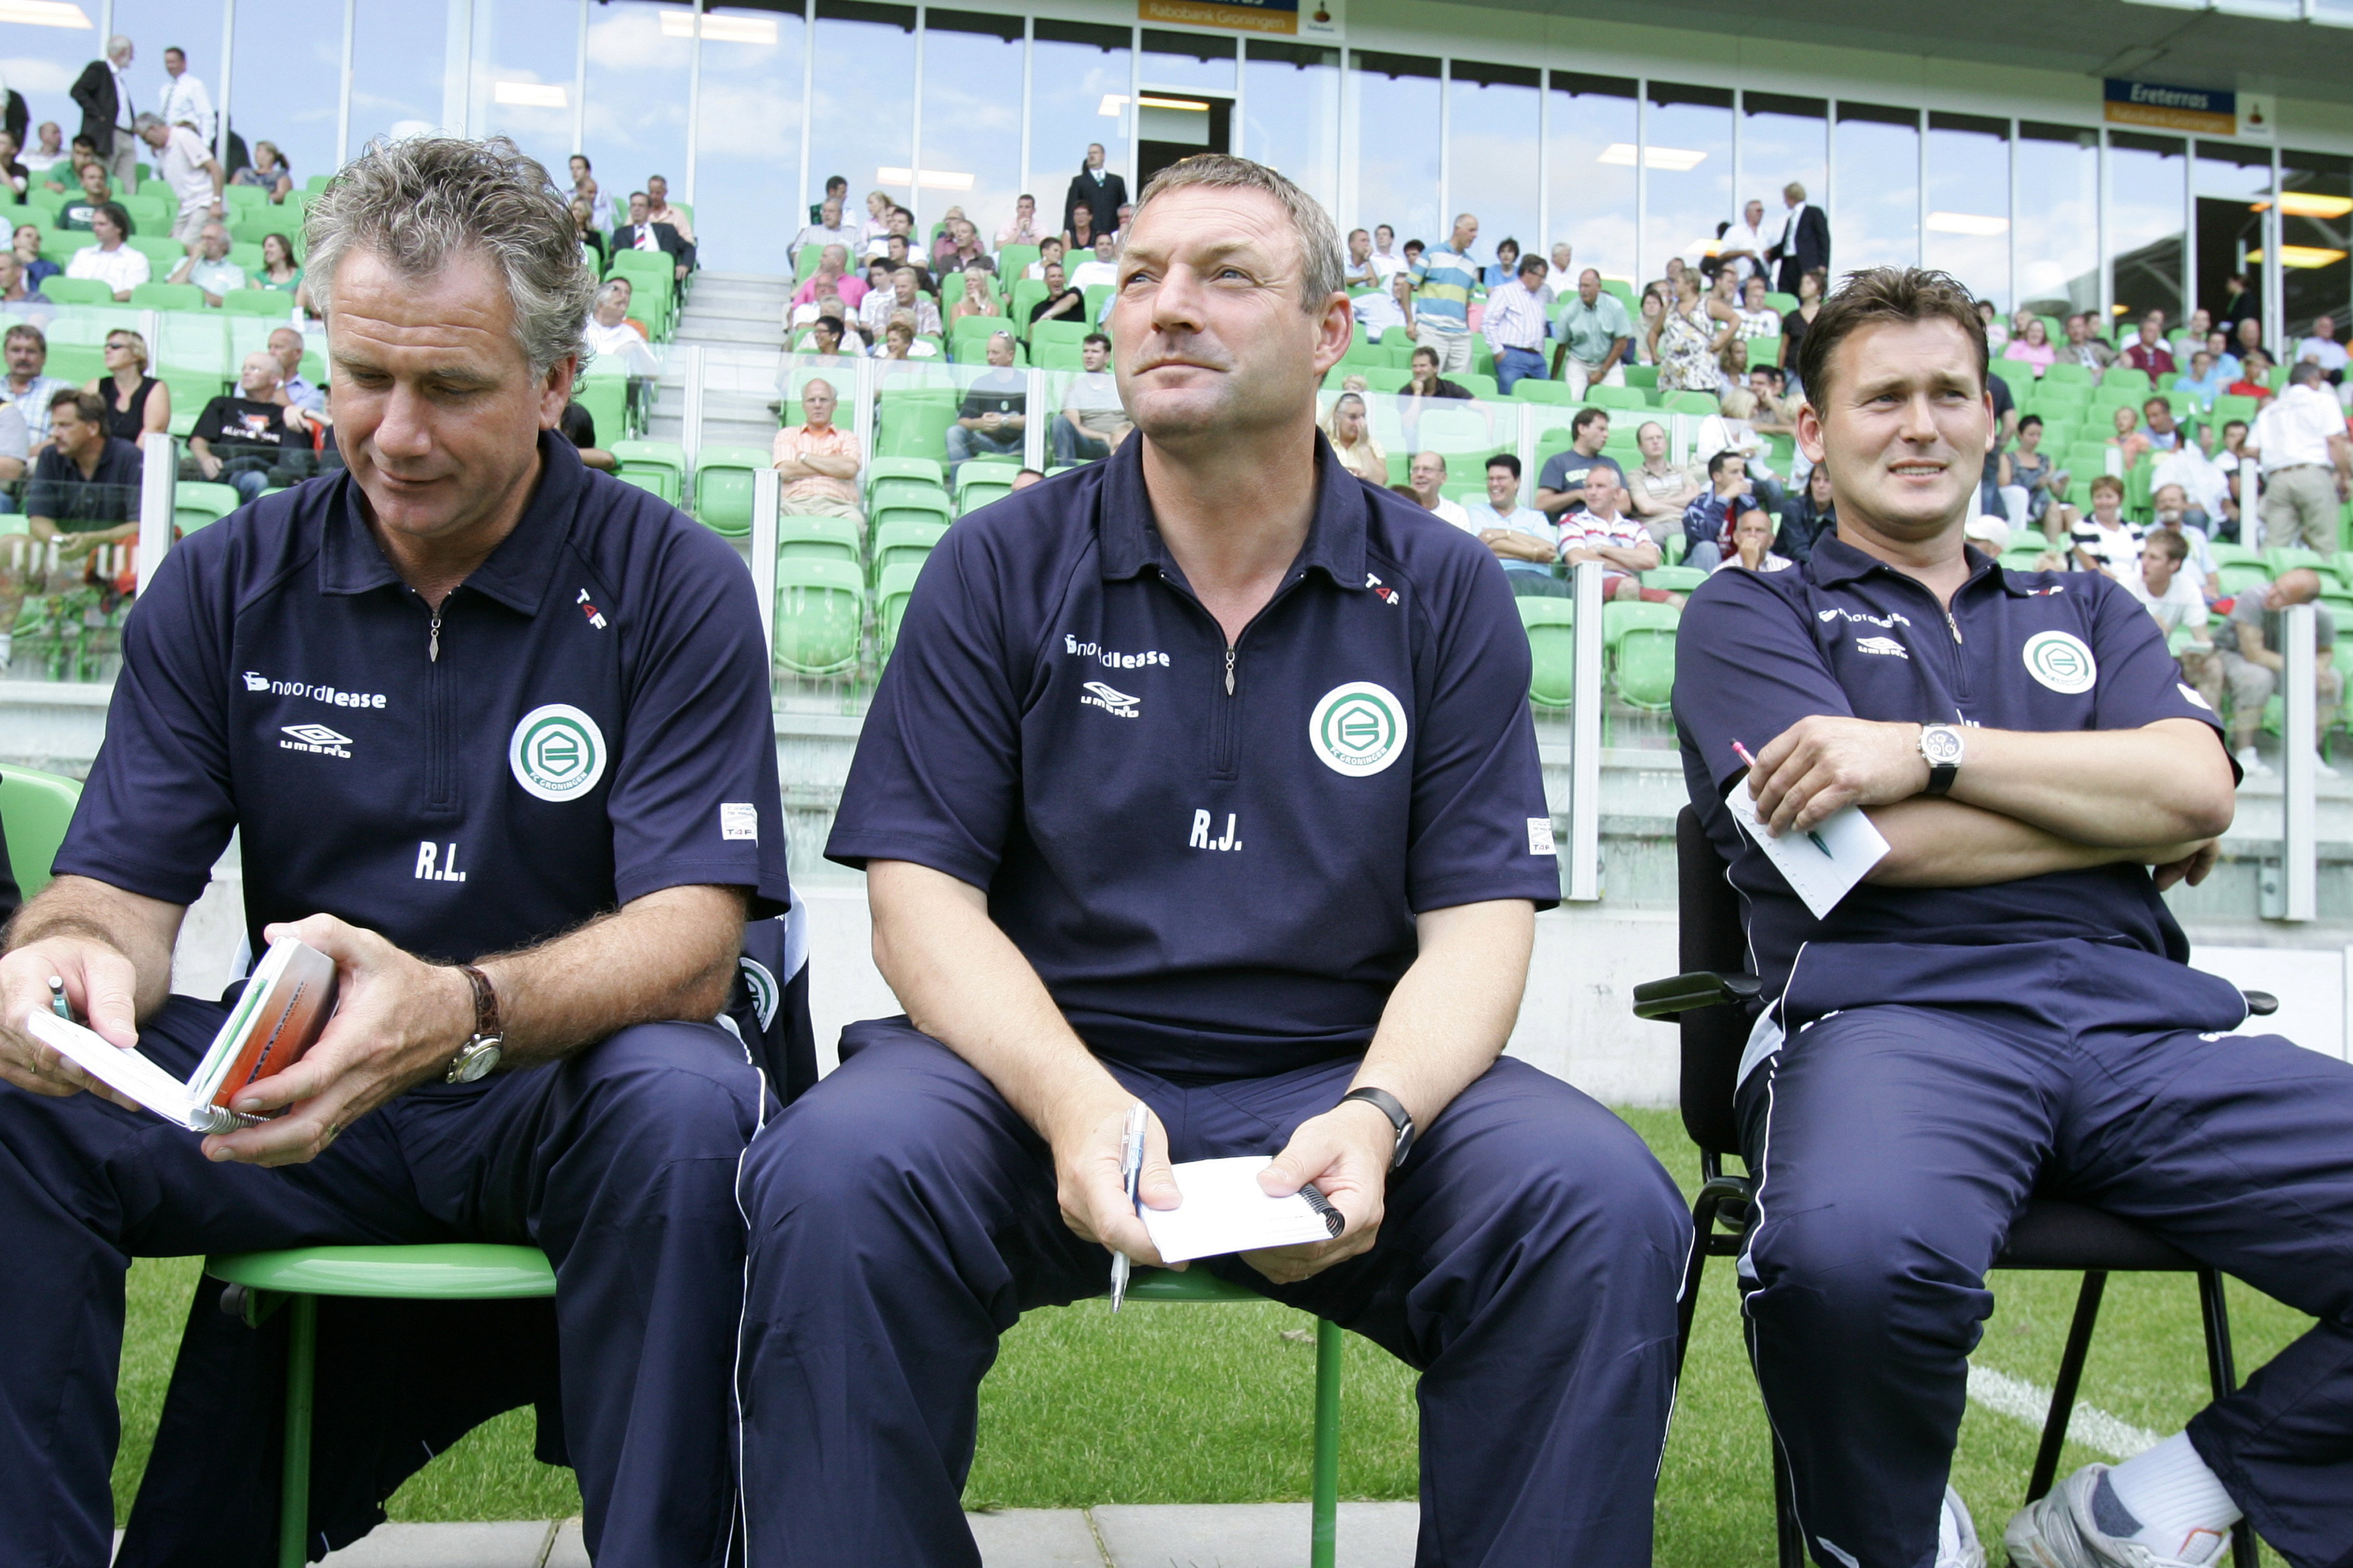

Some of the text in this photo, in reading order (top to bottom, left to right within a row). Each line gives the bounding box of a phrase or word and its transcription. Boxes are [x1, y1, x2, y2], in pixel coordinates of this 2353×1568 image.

[1149, 5, 1286, 31] Rabobank Groningen
[2130, 83, 2209, 110] Ereterras
[1365, 573, 1399, 605] T4F
[577, 588, 607, 629] T4F
[271, 681, 387, 708] noordlease
[540, 772, 588, 790] GRONINGEN
[1189, 808, 1242, 851] R.J.
[415, 841, 466, 882] R.L.
